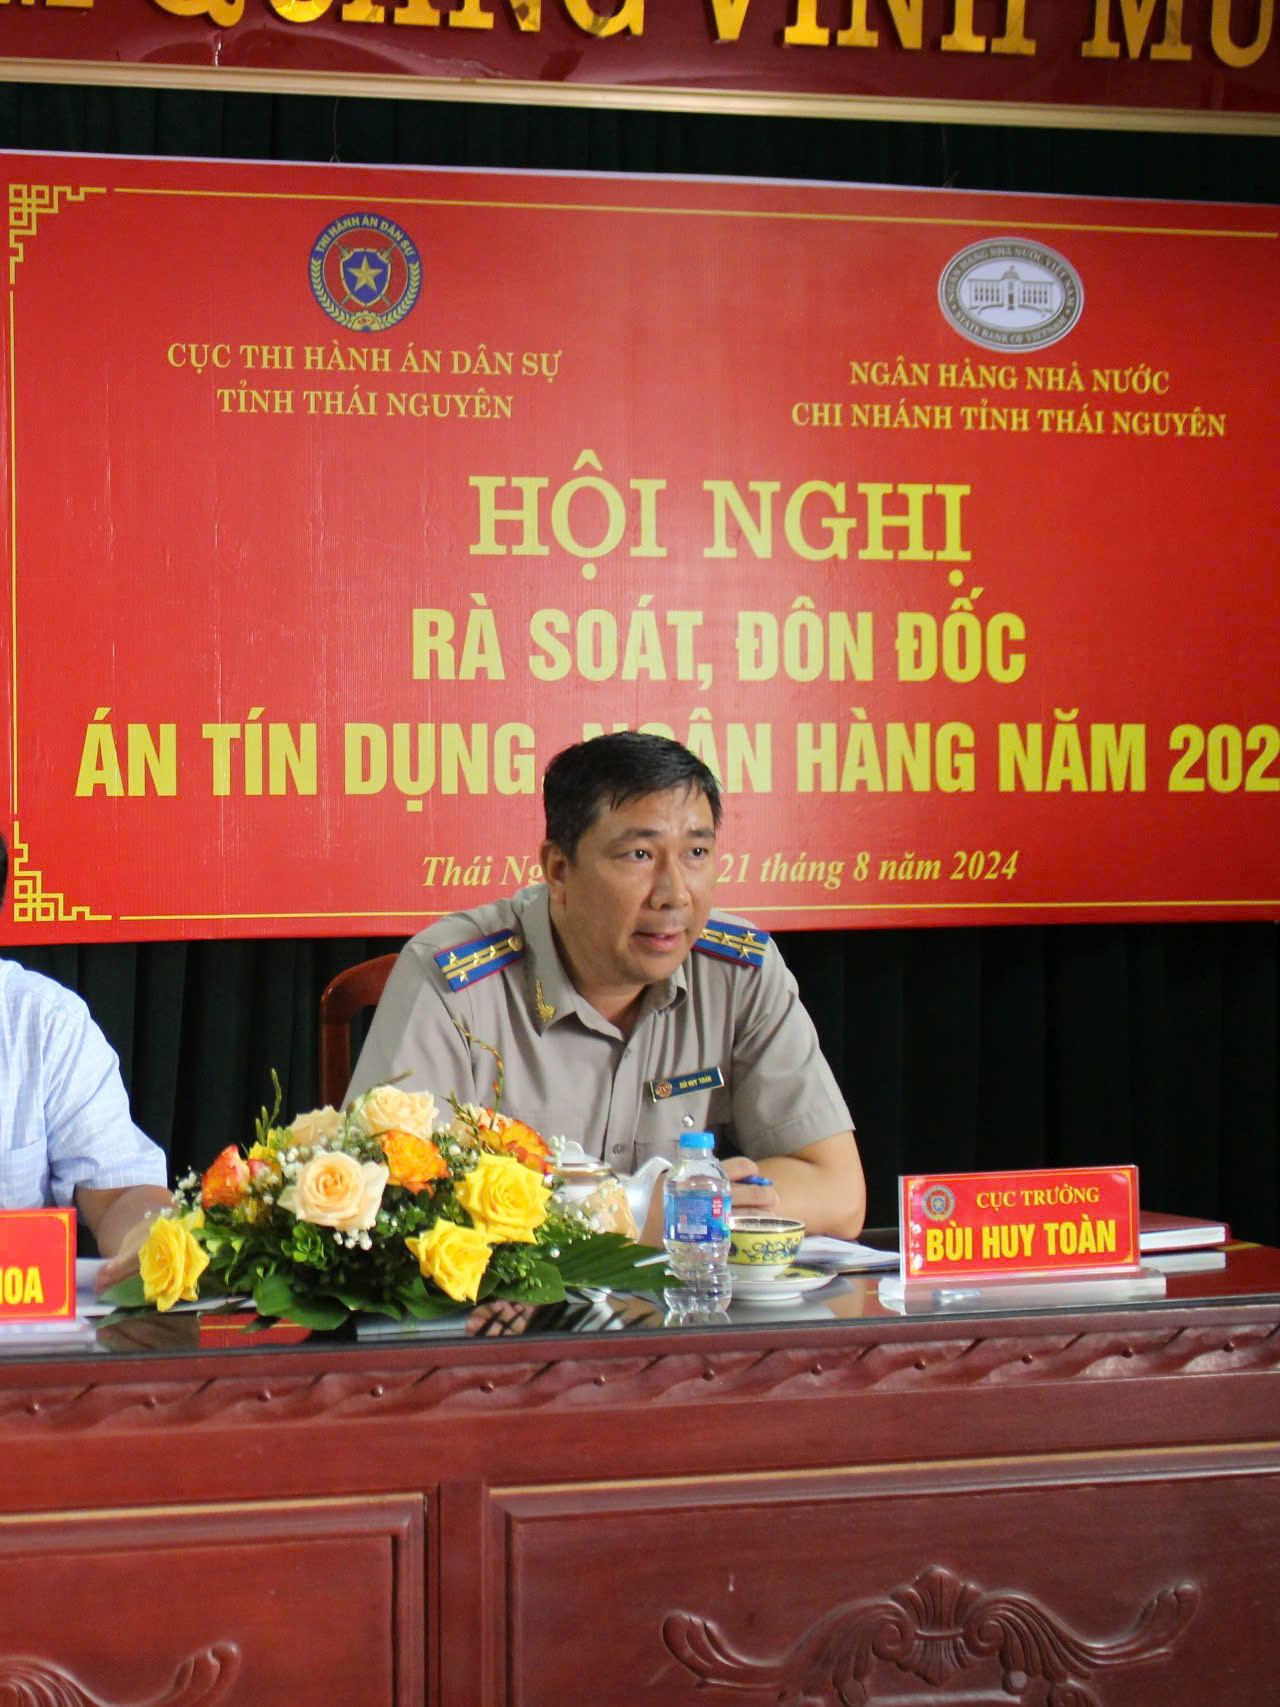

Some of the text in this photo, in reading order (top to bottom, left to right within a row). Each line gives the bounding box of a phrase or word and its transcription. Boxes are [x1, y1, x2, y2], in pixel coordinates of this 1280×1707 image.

[315, 233, 331, 252] THI
[167, 340, 563, 383] CỤC THI HÀNH ÁN DÂN SỰ
[849, 355, 1169, 394] NGÂN HÀNG NHÀ NƯỚC
[216, 380, 513, 419] TỈNH THÁI NGUYÊN
[791, 399, 1226, 437] CHI NHÁNH TỈNH THÁI NGUYÊN
[468, 449, 971, 587] HỘI NGHỊ
[412, 587, 1026, 691] RÀ SOÁT, ĐÔN ĐỐC
[74, 707, 1280, 812] ÁN TÍN DỤNG ÂN HÀNG NĂM 202
[423, 850, 1019, 890] Thái Ng 21 tháng 8 năm 2024
[976, 1183, 1100, 1212] CỤC TRƯỞNG
[926, 1213, 1117, 1262] BÙI HUY TOÀN
